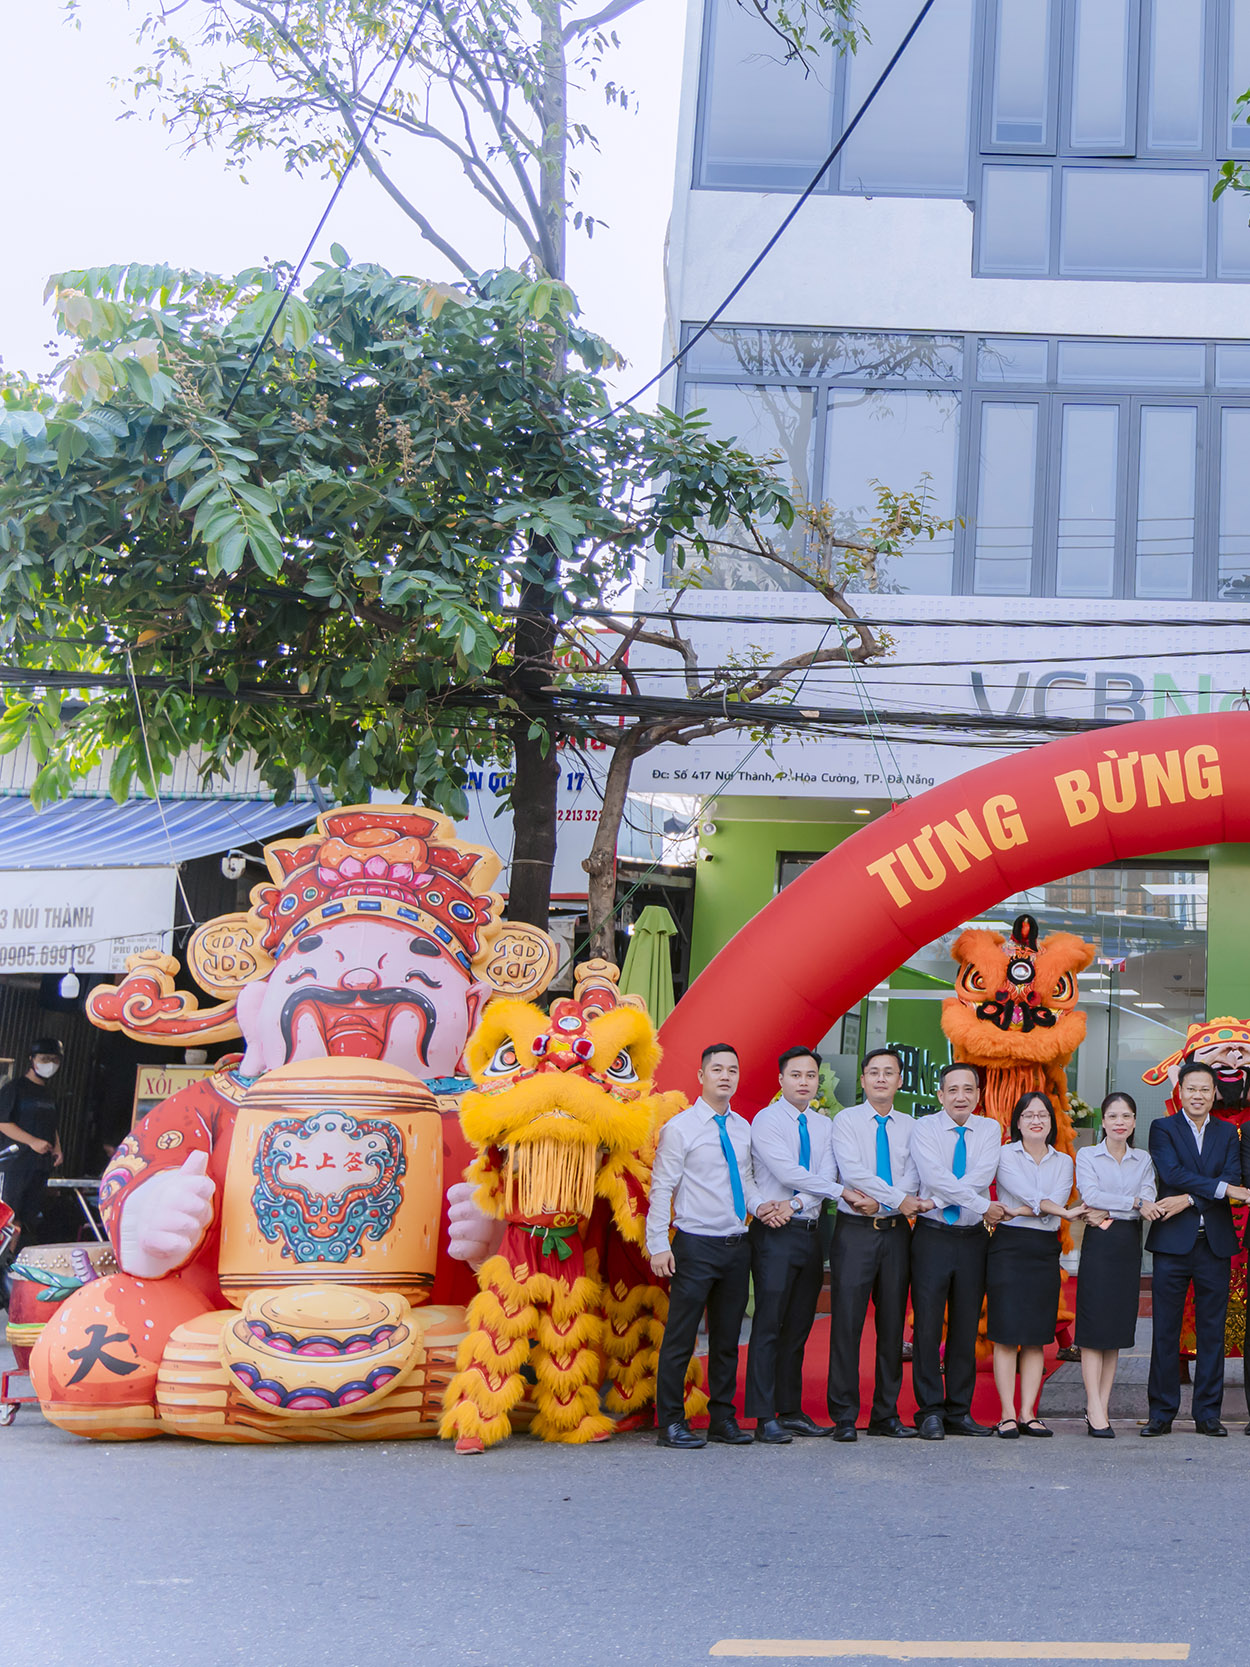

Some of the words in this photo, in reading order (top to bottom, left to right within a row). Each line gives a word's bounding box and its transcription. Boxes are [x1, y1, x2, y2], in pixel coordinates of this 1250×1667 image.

[567, 772, 585, 791] 17
[652, 769, 670, 780] Đc:
[674, 768, 688, 780] Số
[691, 770, 711, 780] 417
[738, 770, 775, 783] Thành,
[821, 773, 860, 785] Cường,
[864, 773, 883, 784] TP.
[906, 774, 935, 787] Nẵng
[565, 809, 583, 821] 213
[866, 794, 1028, 908] TƯNG
[1054, 744, 1223, 827] BỪNG
[12, 904, 40, 929] NÚI
[44, 902, 95, 928] THÀNH
[145, 1072, 172, 1095] XÔI
[66, 1324, 141, 1387] 大
